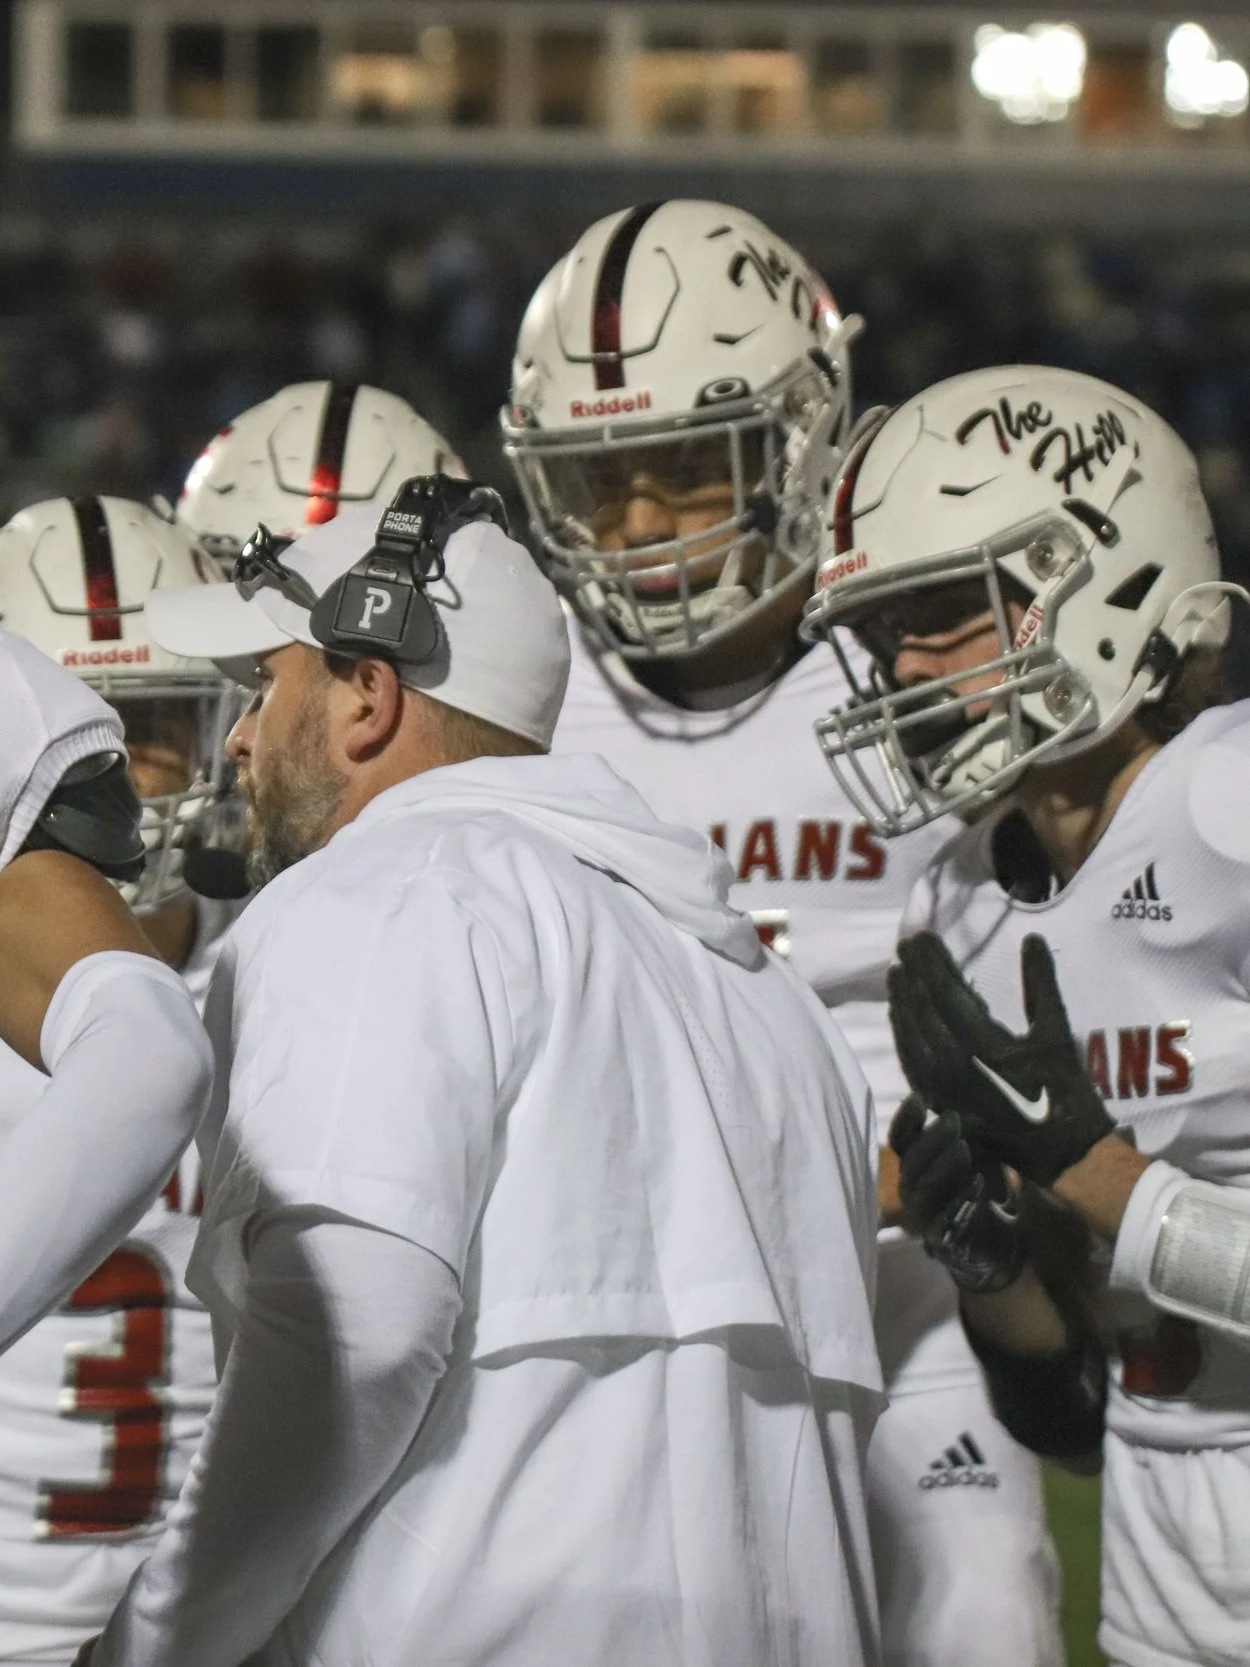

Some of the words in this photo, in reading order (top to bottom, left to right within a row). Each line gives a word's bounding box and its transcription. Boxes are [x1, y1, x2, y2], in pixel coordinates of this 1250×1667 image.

[570, 390, 652, 418] Riddell
[955, 396, 1053, 456] The
[383, 519, 421, 534] PHONE
[386, 511, 422, 525] PORTA
[63, 645, 151, 667] Riddell
[1111, 896, 1173, 922] adidas
[917, 1467, 999, 1491] adidas
